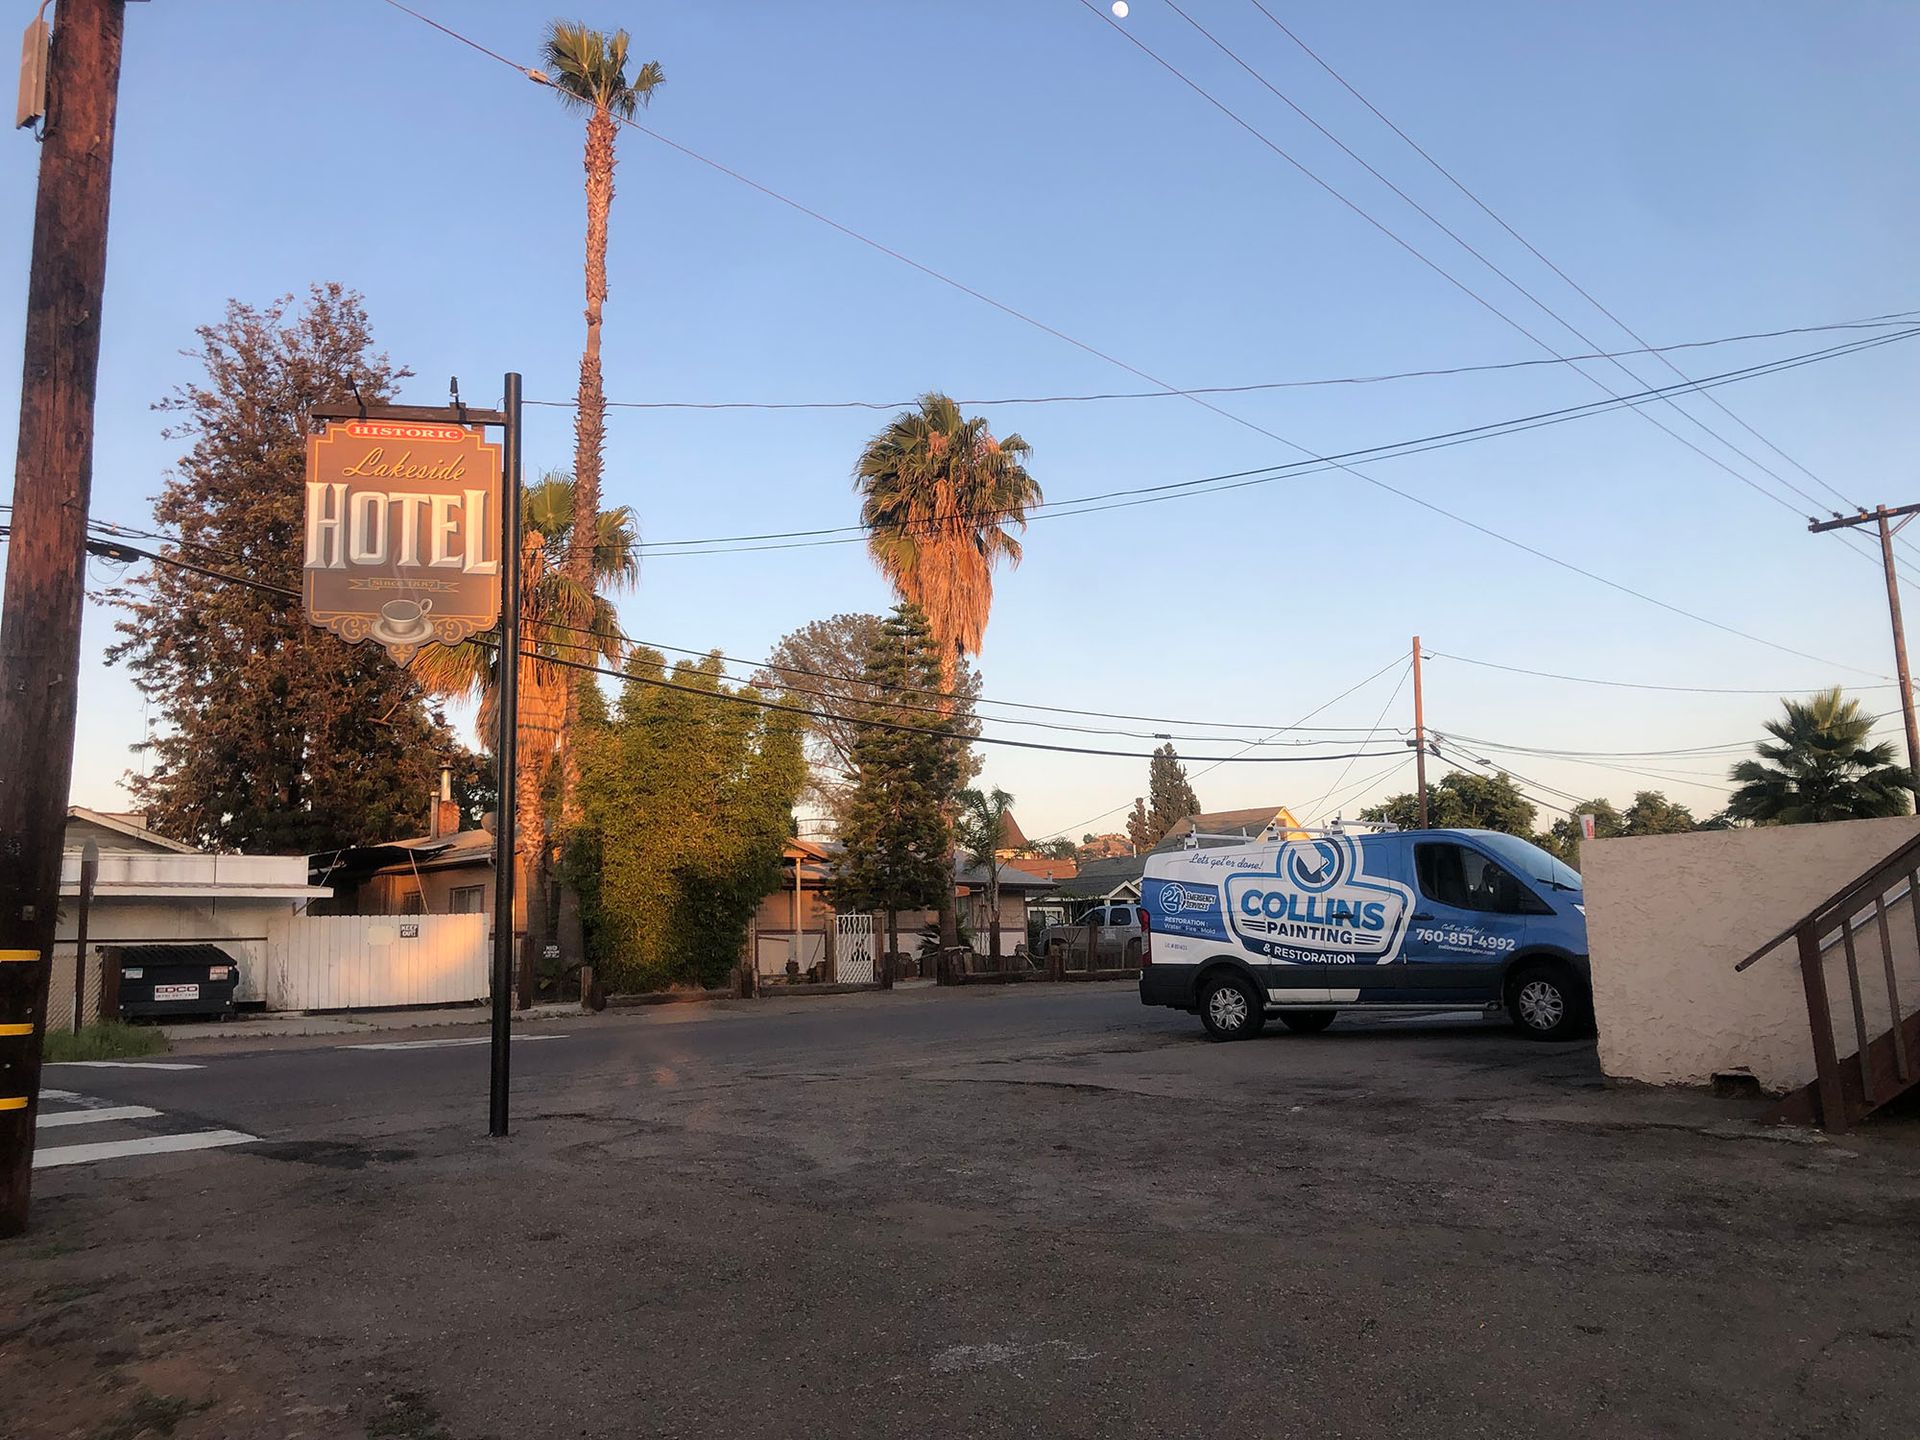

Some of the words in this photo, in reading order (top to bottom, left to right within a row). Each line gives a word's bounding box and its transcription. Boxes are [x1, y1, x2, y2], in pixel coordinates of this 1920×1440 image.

[354, 426, 459, 439] HISTORIC
[343, 447, 466, 481] Lakeside
[303, 482, 498, 575] HOTEL
[1236, 857, 1264, 870] done!
[1162, 885, 1182, 913] 24
[1185, 901, 1209, 911] SERVICES
[1186, 892, 1216, 904] EMERGENCY
[1240, 889, 1386, 931] COLLINS
[1267, 921, 1353, 945] PAINTING
[1415, 928, 1516, 951] 760-851-4992
[1263, 943, 1271, 953] &
[1274, 946, 1356, 964] RESTORATION
